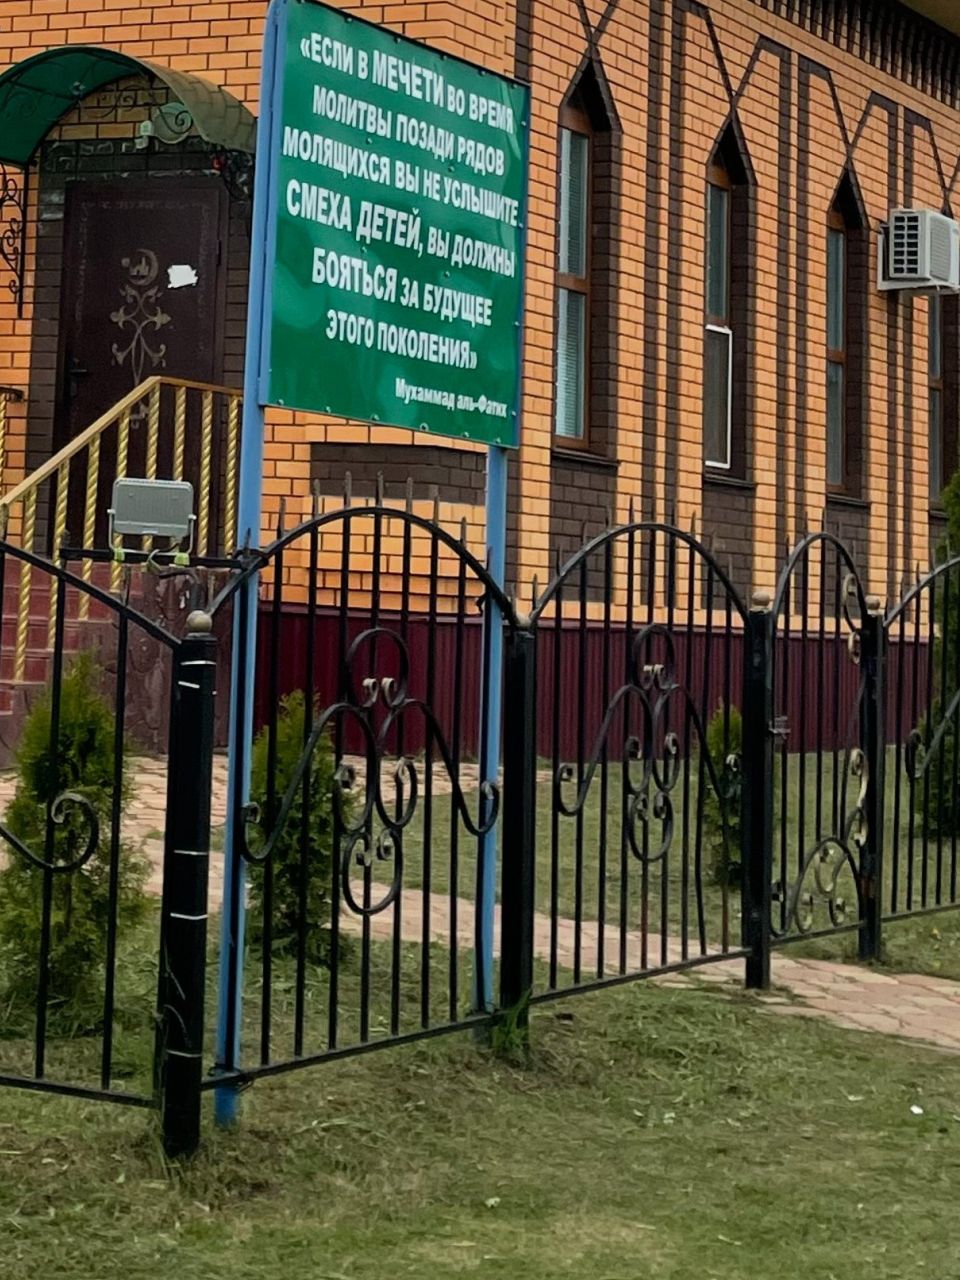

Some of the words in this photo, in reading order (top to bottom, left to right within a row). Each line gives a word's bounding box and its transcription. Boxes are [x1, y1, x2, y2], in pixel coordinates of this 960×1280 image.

[300, 32, 353, 76] «ЕСЛИ
[357, 50, 369, 80] В
[372, 50, 444, 108] МЕЧЕТИ
[447, 83, 466, 117] ВО
[468, 92, 514, 135] ВРЕМЯ
[282, 125, 391, 186] МОЛЯЩИХСЯ
[394, 160, 420, 194] ВЫ
[422, 168, 440, 202] НЕ
[312, 85, 392, 139] МОЛИТВЫ
[396, 113, 454, 163] ПОЗАДИ
[456, 135, 505, 177] РЯДОВ
[286, 178, 353, 233] СМЕХА
[355, 200, 424, 259] ДЕТЕЙ,
[427, 226, 451, 260] ВЫ
[450, 234, 516, 278] ДОЛЖНЫ
[311, 246, 398, 304] БОЯТЬСЯ
[399, 276, 420, 310] ЗА
[422, 282, 494, 328] БУДУЩЕЕ
[325, 308, 374, 349] ЭТОГО
[376, 321, 478, 370] ПОКОЛЕНИЯ»
[395, 377, 456, 411] Мухаммад
[456, 393, 508, 419] аль-Фатих
